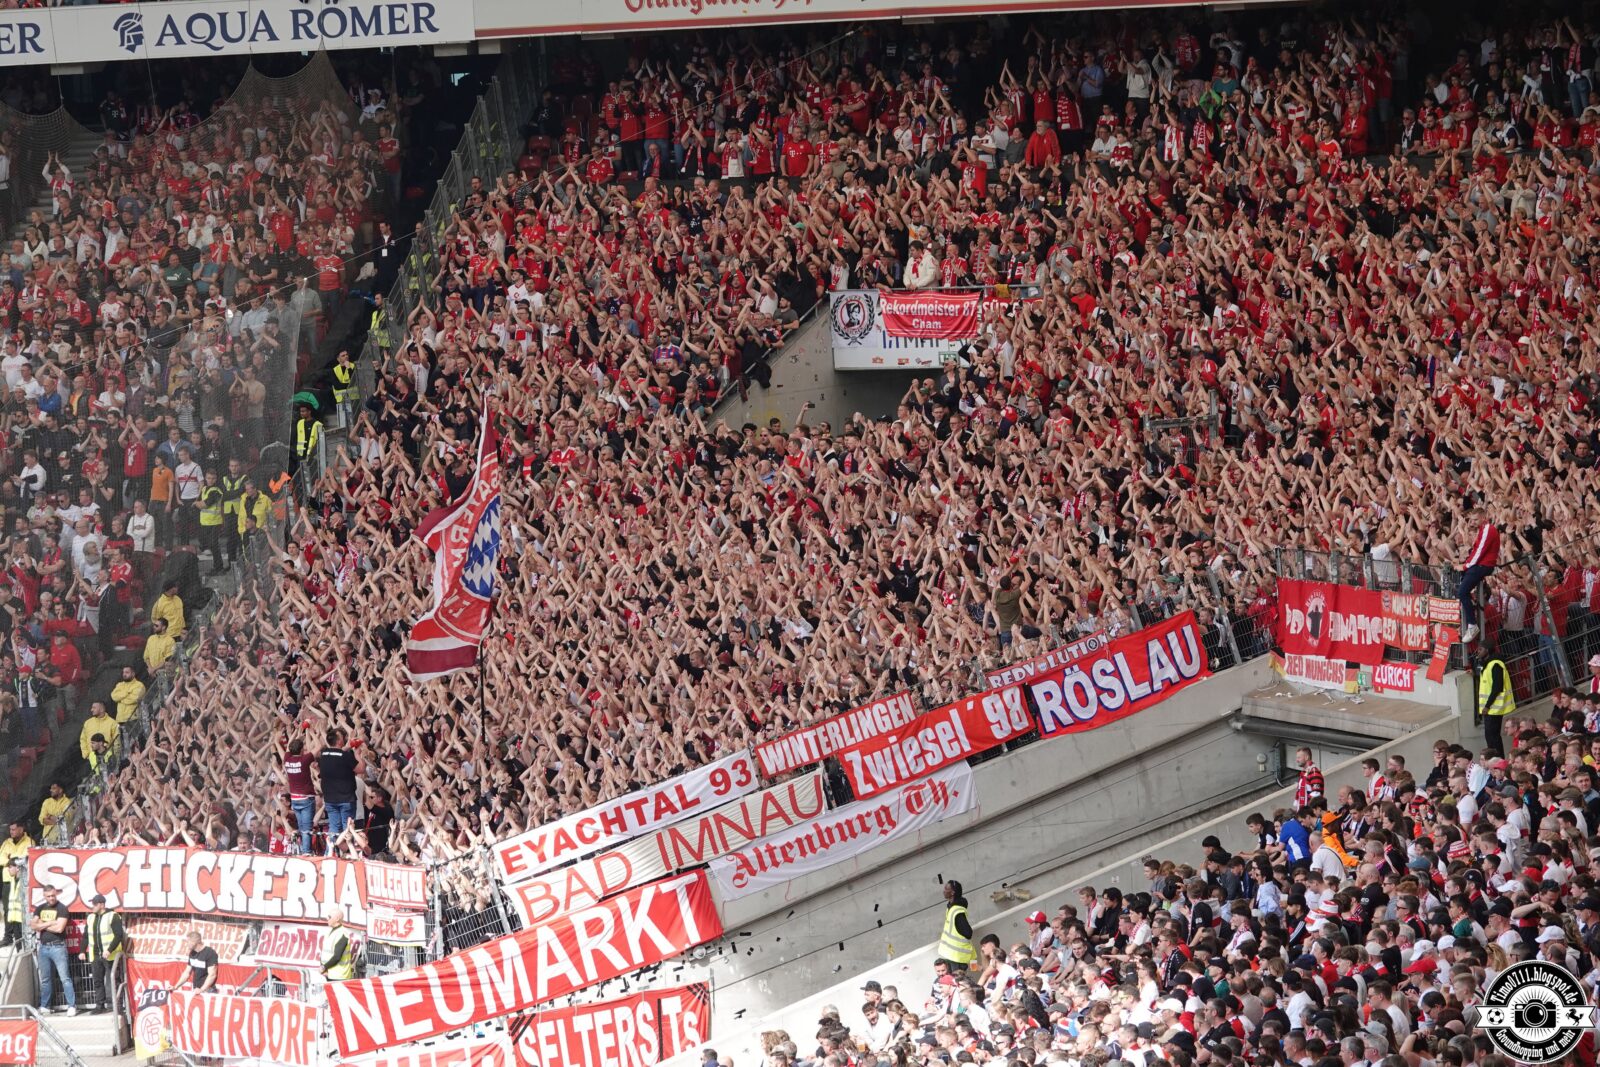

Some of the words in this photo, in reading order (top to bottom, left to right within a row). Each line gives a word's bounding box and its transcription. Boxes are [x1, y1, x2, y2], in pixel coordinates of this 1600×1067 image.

[155, 10, 279, 51] AQUA
[289, 0, 439, 40] RÖMER
[879, 298, 960, 317] Rekordmeister
[962, 300, 978, 317] 87
[912, 318, 942, 330] Cham
[1031, 624, 1201, 733] RÖSLAU
[1286, 655, 1303, 676] RED
[758, 692, 918, 775] WINTERLINGEN
[845, 708, 971, 796] Zwiesel
[501, 783, 700, 876] EYACHTAL
[709, 758, 752, 796] 93
[516, 851, 634, 924] BAD
[656, 774, 825, 872] IMNAU
[725, 804, 897, 888] Altenburg
[31, 849, 367, 926] SCHICKERIA
[330, 873, 700, 1052] NEUMARKT
[171, 991, 318, 1065] ROHRDORF
